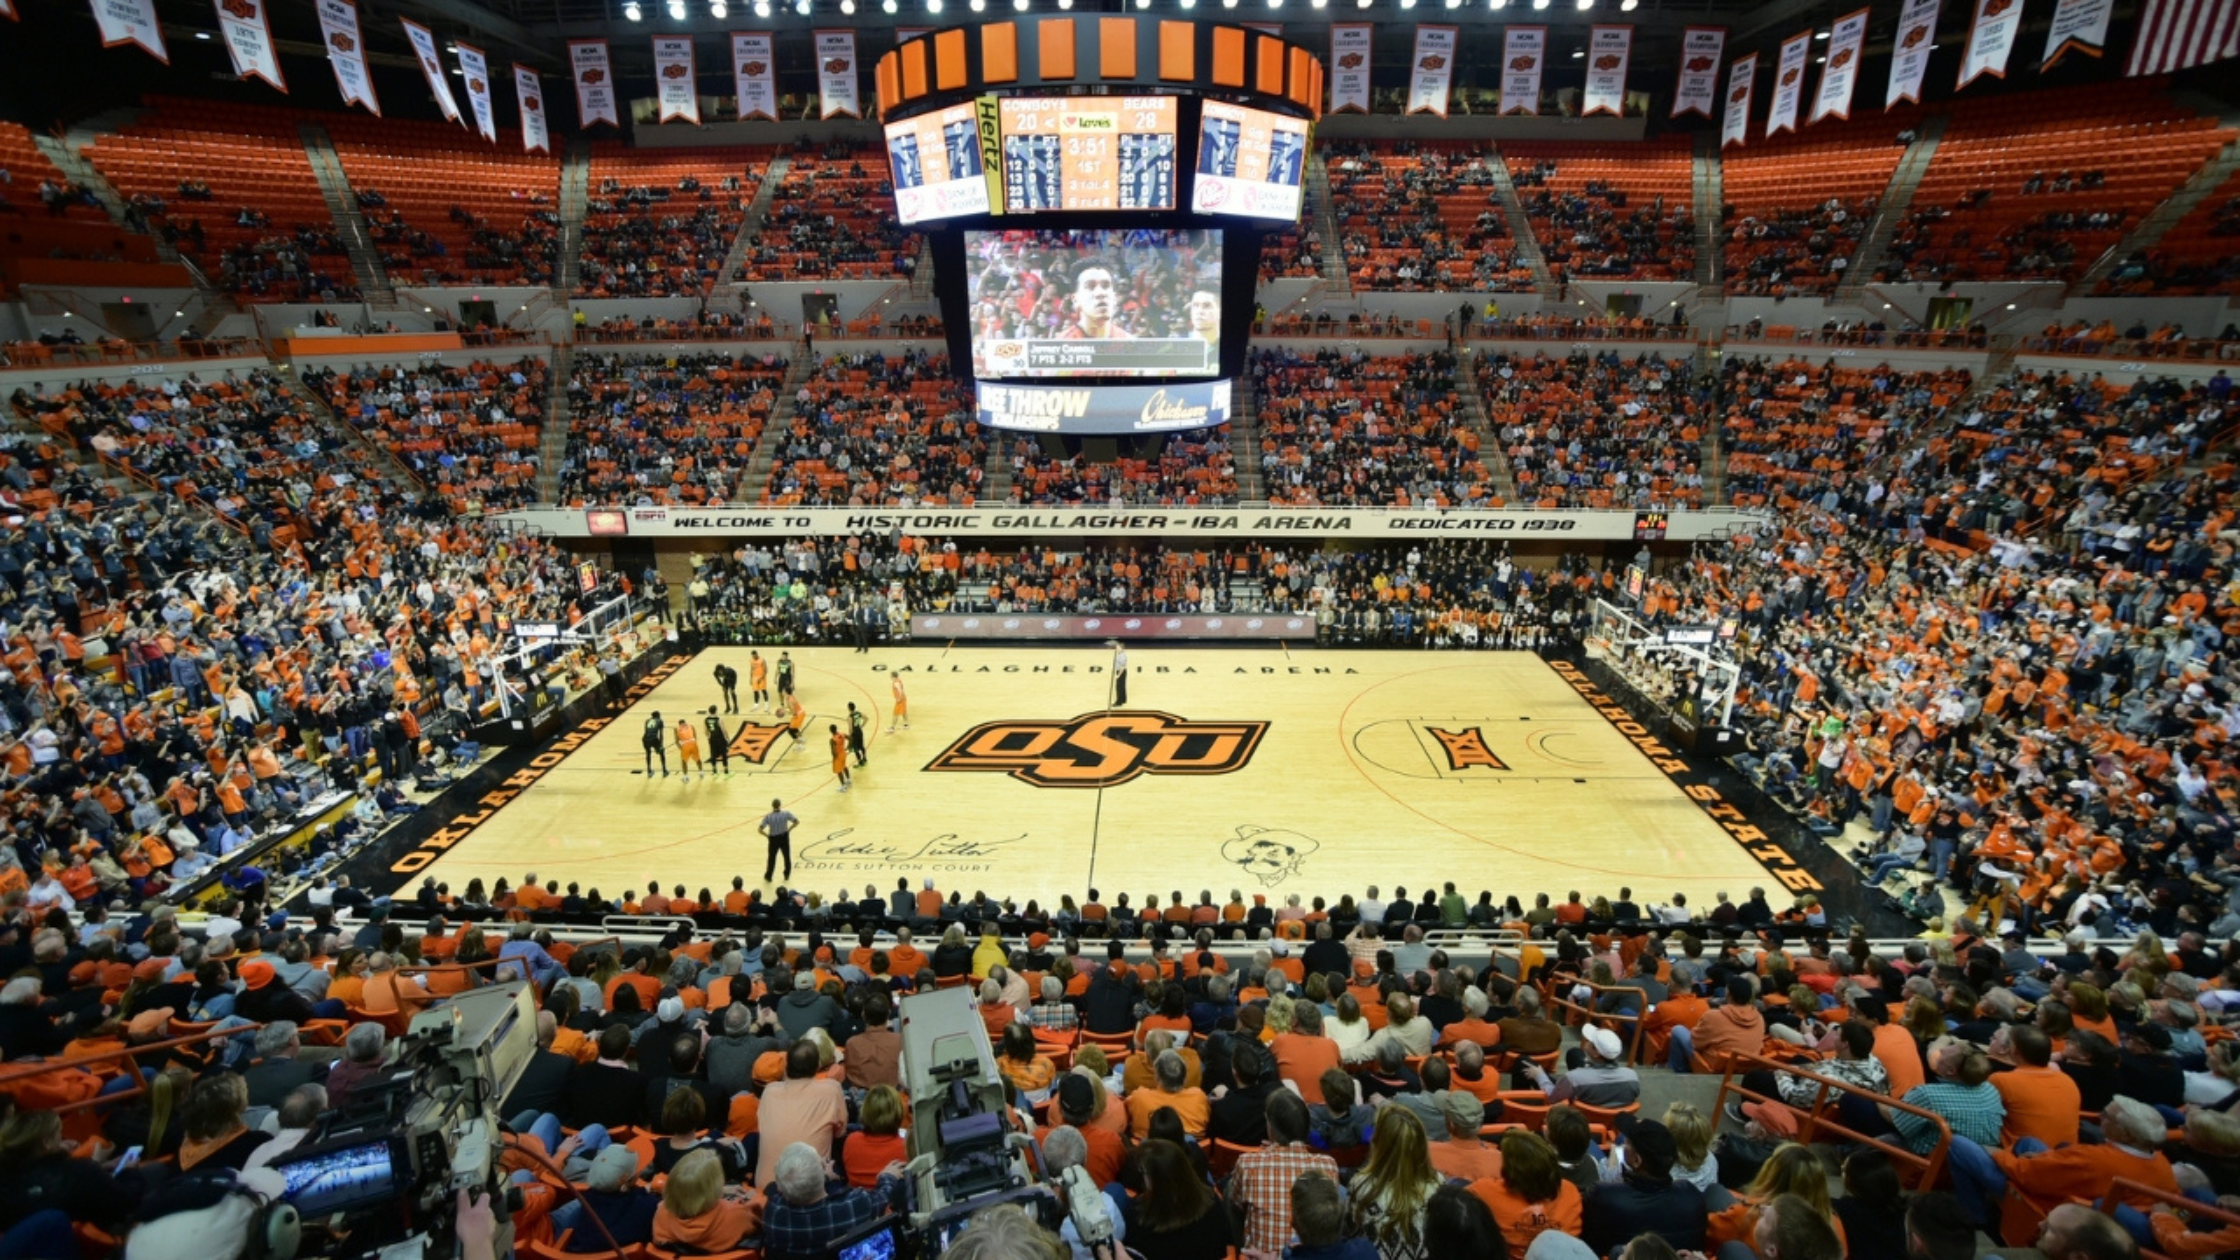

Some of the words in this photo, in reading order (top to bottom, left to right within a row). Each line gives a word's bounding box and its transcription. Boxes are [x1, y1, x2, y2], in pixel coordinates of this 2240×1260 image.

[1002, 98, 1068, 111] COWBOYS
[1123, 97, 1166, 110] BEARS
[1017, 113, 1037, 130] 20
[1135, 111, 1156, 129] 28
[979, 101, 1000, 172] Hertz
[1007, 135, 1023, 146] PL
[1043, 136, 1058, 146] PT
[1121, 134, 1136, 145] PL
[1158, 134, 1173, 145] PT
[1068, 137, 1107, 155] 3:51
[1008, 160, 1023, 171] 12
[1078, 161, 1101, 173] 1ST
[1157, 160, 1171, 171] 10
[1009, 173, 1023, 184] 13
[1121, 173, 1135, 183] 20
[1013, 358, 1025, 369] 30
[1039, 355, 1056, 365] PTS
[1008, 388, 1092, 418] THROW
[674, 516, 775, 528] WELCOME
[783, 516, 812, 528] TO
[845, 515, 982, 529] HISTORIC
[1252, 516, 1353, 529] ARENA
[1388, 518, 1516, 530] DEDICATED
[1520, 519, 1576, 530] 1938
[871, 664, 1104, 673] GALLAGHER
[1234, 666, 1359, 674] ARENA
[926, 711, 1266, 787] OSU
[1550, 660, 1691, 776] OKLAHOMA
[1684, 784, 1826, 891] STATE
[390, 716, 614, 873] OKLAHOMA
[799, 827, 906, 862] Eddie
[886, 833, 1028, 862] Sutton
[794, 862, 845, 870] EDDIE
[853, 862, 923, 871] SUTTON
[932, 863, 993, 873] COURT
